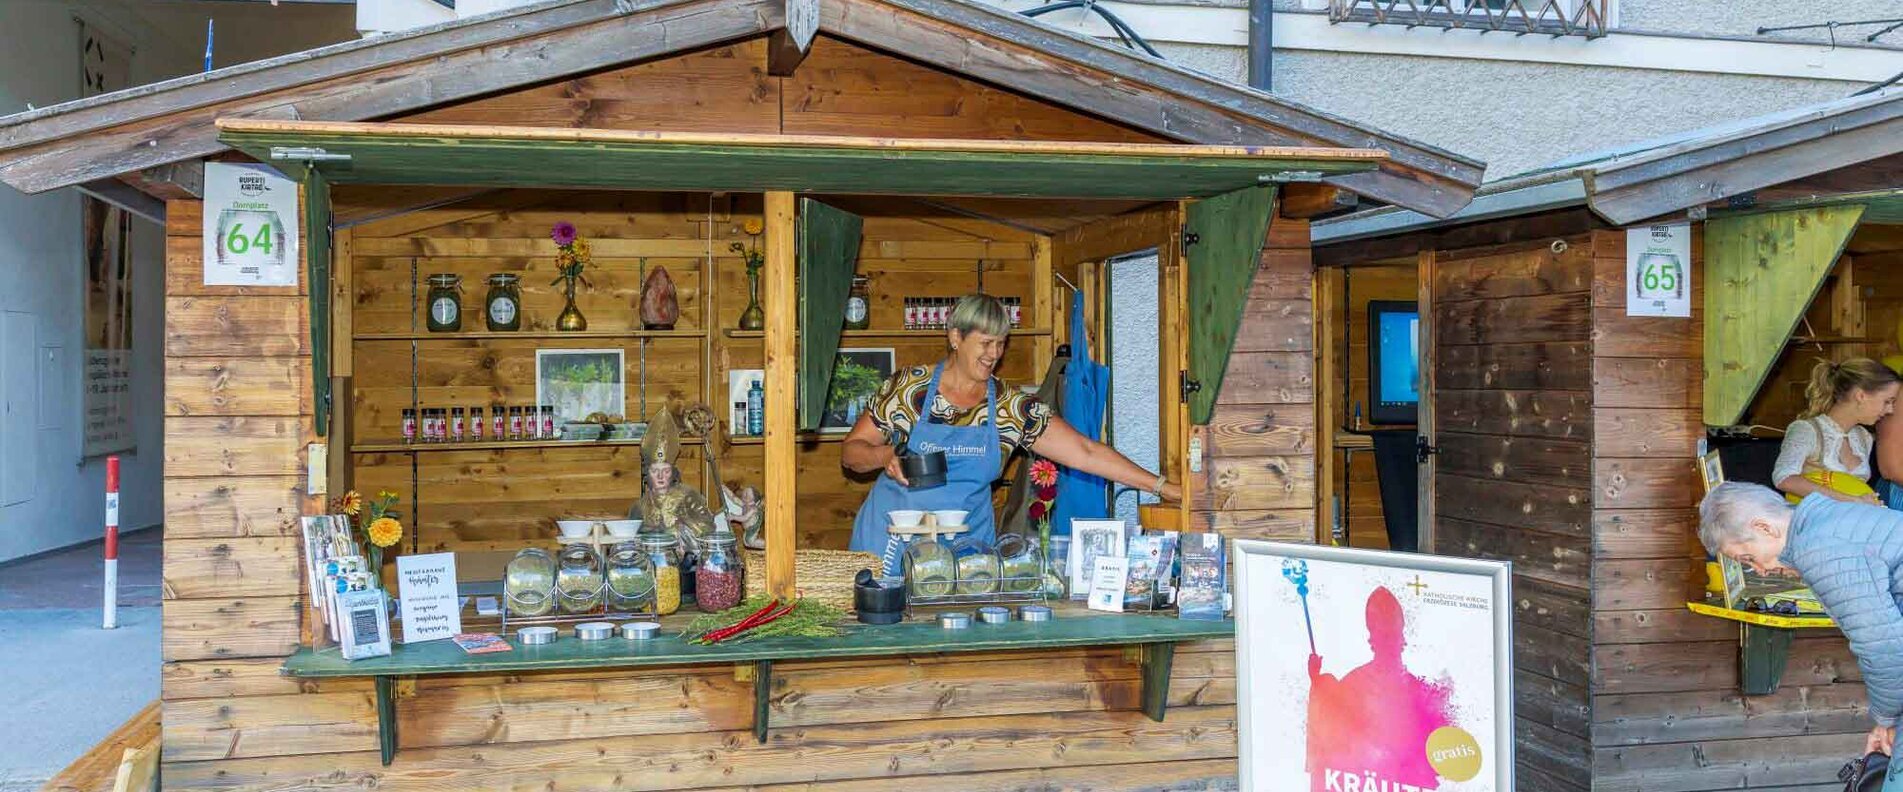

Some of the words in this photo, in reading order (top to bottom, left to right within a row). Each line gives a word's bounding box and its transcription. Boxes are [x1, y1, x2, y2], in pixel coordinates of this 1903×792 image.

[233, 201, 269, 209] Domplatz
[227, 223, 273, 255] 64
[1643, 264, 1674, 290] 65
[952, 444, 987, 454] Himmel
[1431, 744, 1475, 763] gratis
[1325, 768, 1437, 792] KRÄUT
